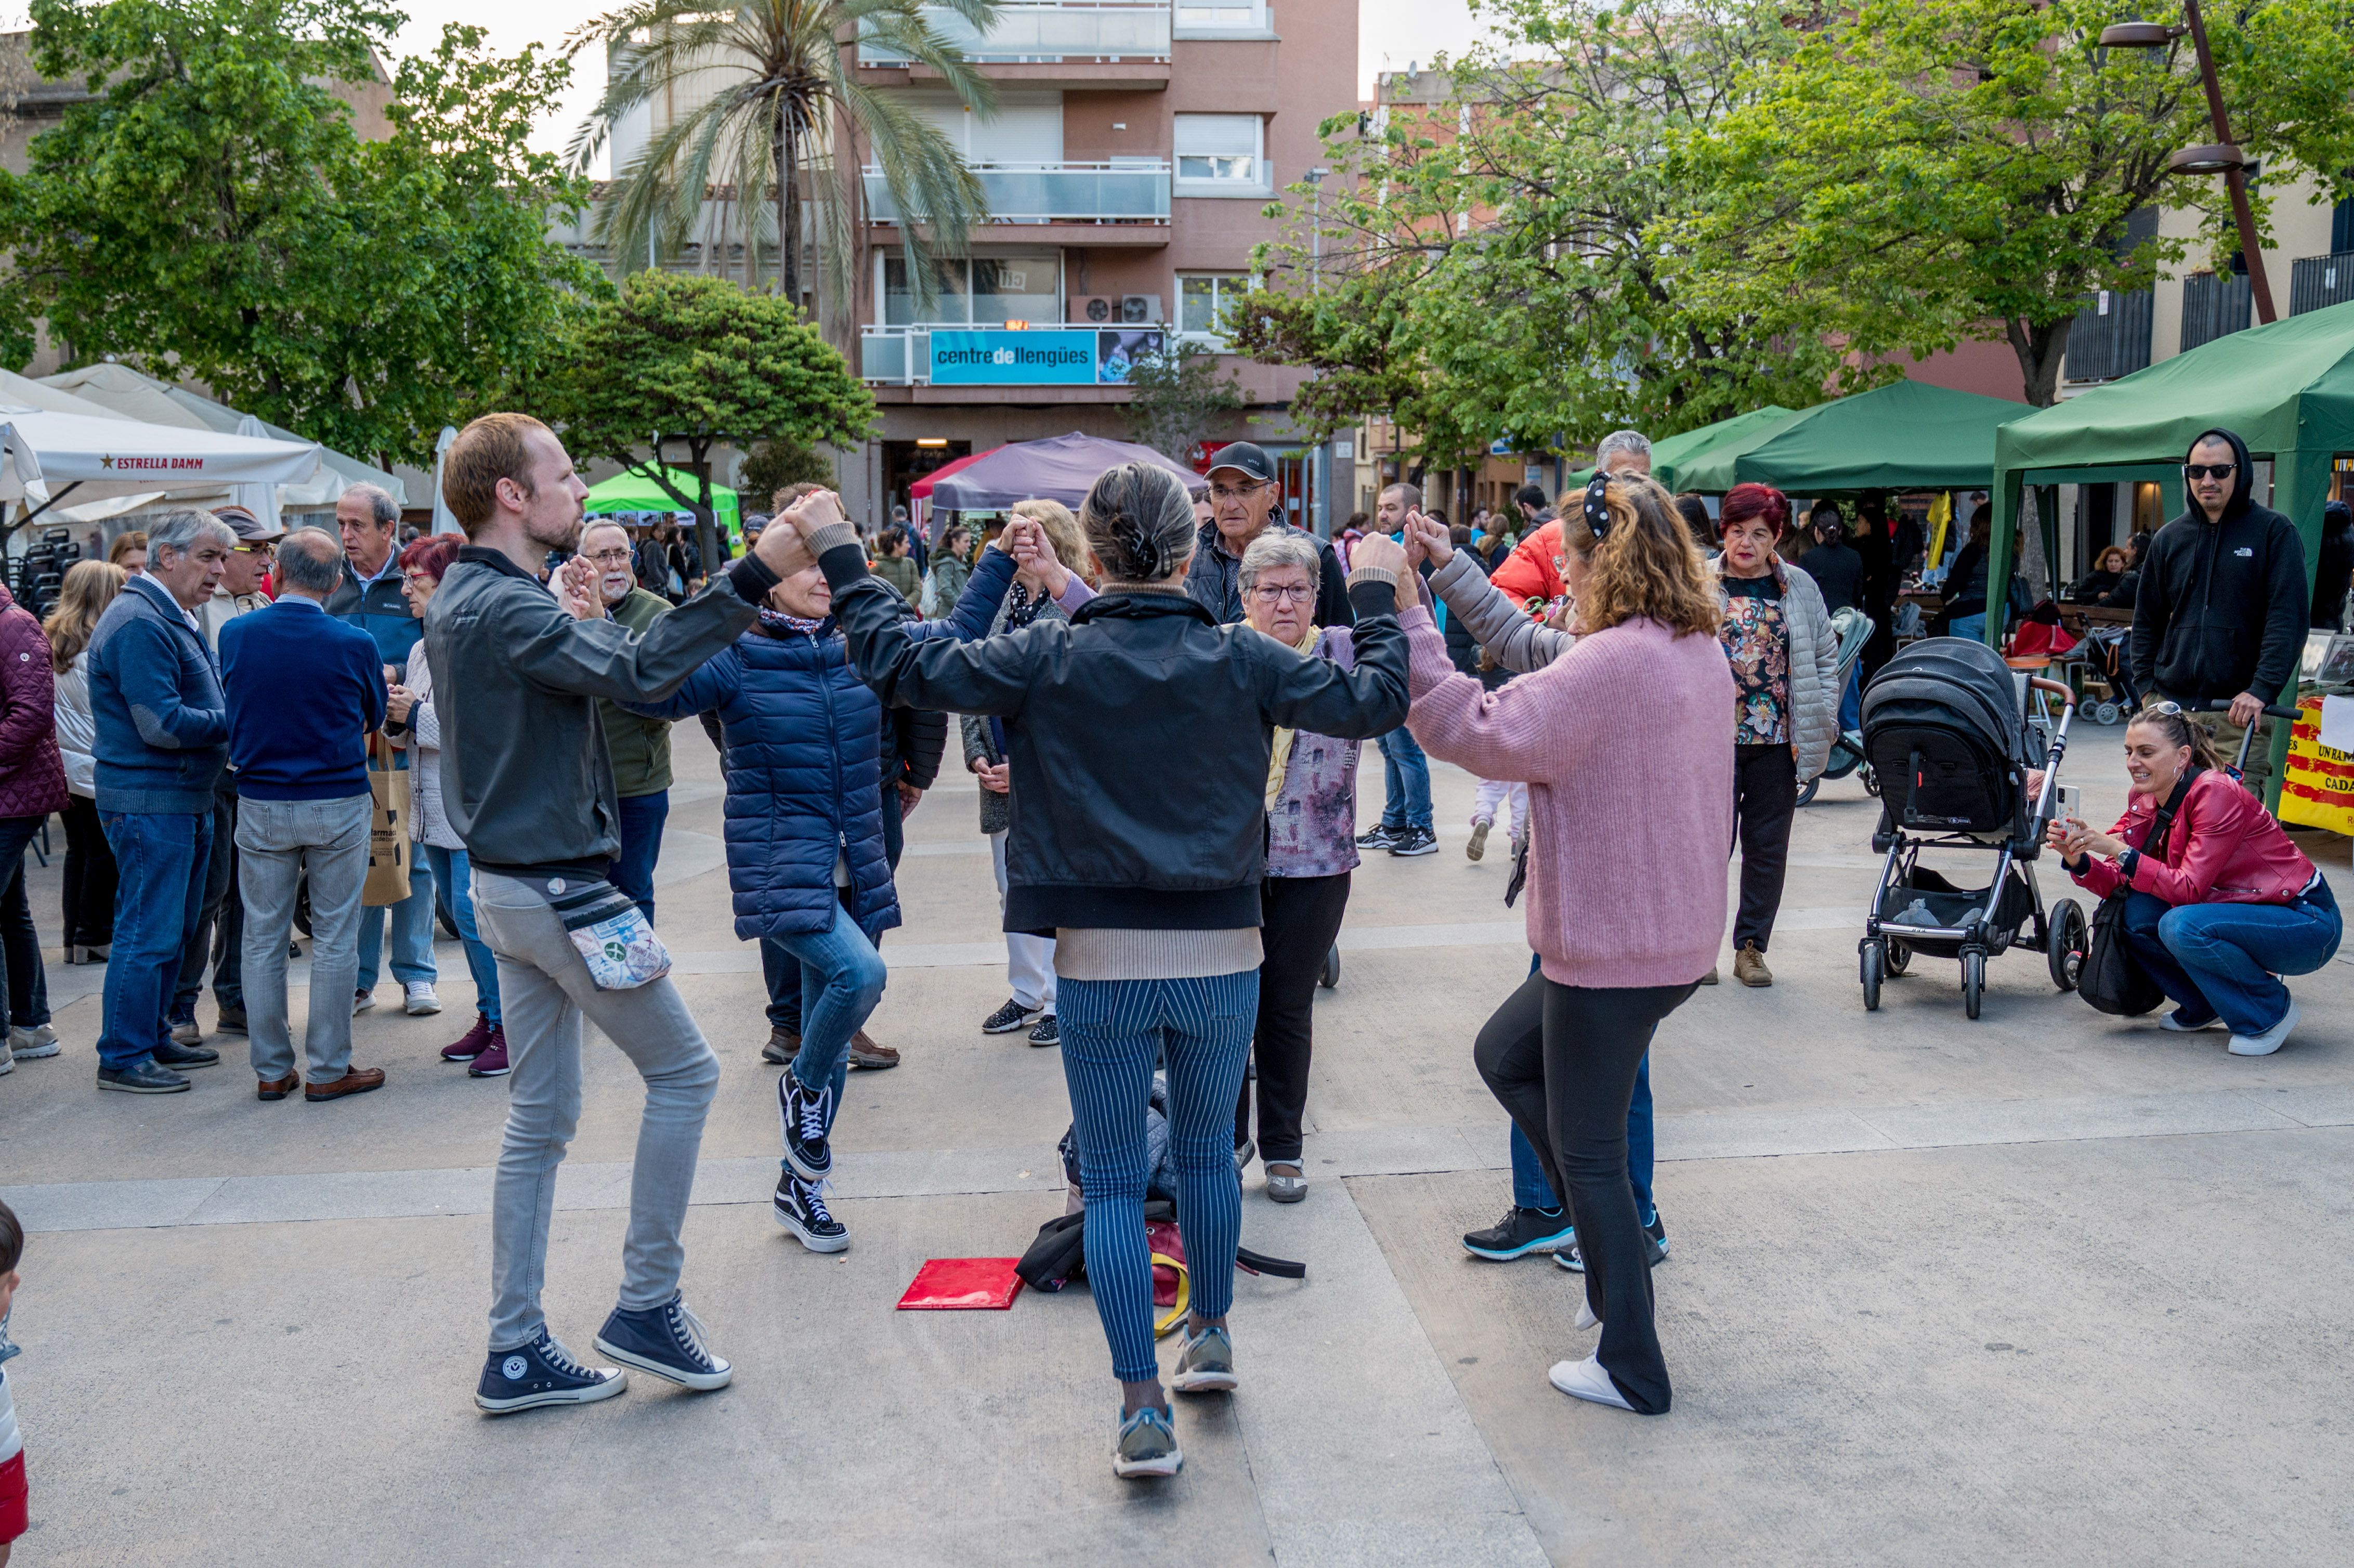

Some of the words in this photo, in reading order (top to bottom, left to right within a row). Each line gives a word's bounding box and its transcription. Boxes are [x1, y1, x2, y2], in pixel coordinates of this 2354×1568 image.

[937, 346, 1089, 368] centredellengües
[117, 458, 168, 469] ESTRELLA
[171, 459, 204, 469] DAMM
[2334, 459, 2354, 472] VIVA
[631, 944, 647, 957] HONG
